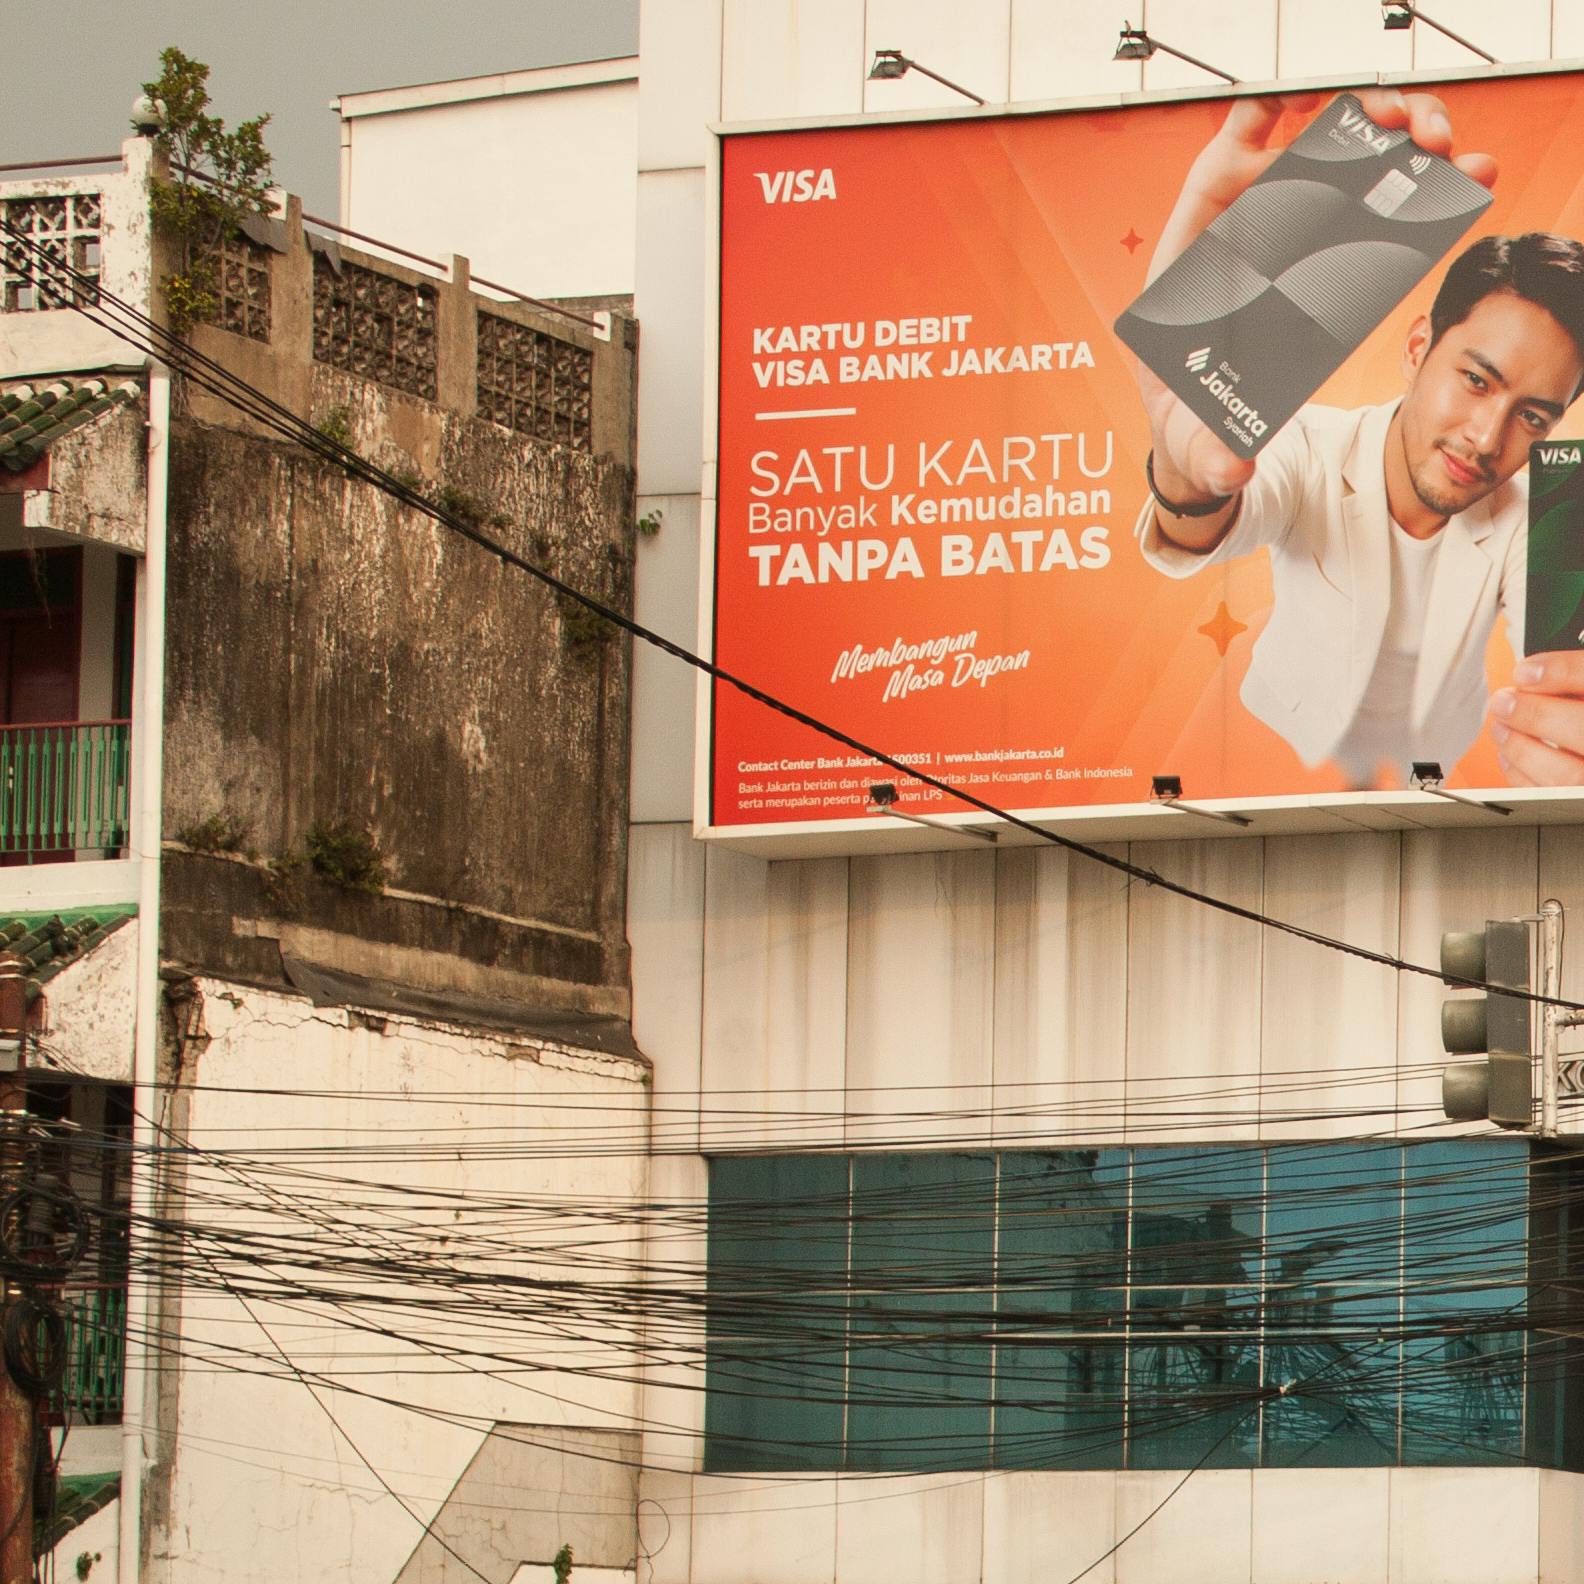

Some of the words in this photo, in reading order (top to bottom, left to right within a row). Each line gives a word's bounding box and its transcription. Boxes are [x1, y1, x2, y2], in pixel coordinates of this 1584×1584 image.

[1339, 103, 1391, 157] VISA
[753, 168, 837, 204] VISA
[753, 323, 865, 355] KARTU
[874, 315, 973, 348] DEBIT
[752, 356, 830, 389] VISA
[839, 351, 934, 383] BANK
[941, 341, 1096, 378] JAKARTA
[1219, 361, 1242, 384] Bank
[1199, 371, 1269, 438] Jakarta
[1222, 416, 1255, 448] Syariah
[749, 443, 895, 498] SATU
[918, 431, 1114, 488] KARTU
[1536, 447, 1582, 466] VISA
[748, 496, 878, 537] Banyak
[890, 484, 1111, 526] Kemudahan
[748, 537, 925, 587] TANPA
[941, 526, 1112, 577] BATAS
[830, 629, 978, 683] Membangun
[882, 664, 944, 702] Masa
[950, 648, 1031, 688] Depan
[738, 760, 779, 773] Contact
[780, 759, 815, 772] Center
[817, 757, 844, 769] Bank
[845, 755, 884, 768] Jakarta
[944, 747, 1065, 764] www.bankjakarta.co.id
[738, 783, 763, 794] Bank
[766, 780, 801, 793] Jakarta
[803, 778, 838, 791] berizin
[839, 778, 859, 789] dan
[968, 772, 990, 784] Jasa
[992, 770, 1042, 785] Keuangan
[1044, 770, 1054, 780] &
[1056, 768, 1082, 780] Bank
[1084, 766, 1133, 779] Indonesia
[738, 798, 764, 810] serta
[765, 795, 821, 810] merupakan
[823, 794, 861, 807] peserta
[923, 789, 943, 801] LPS
